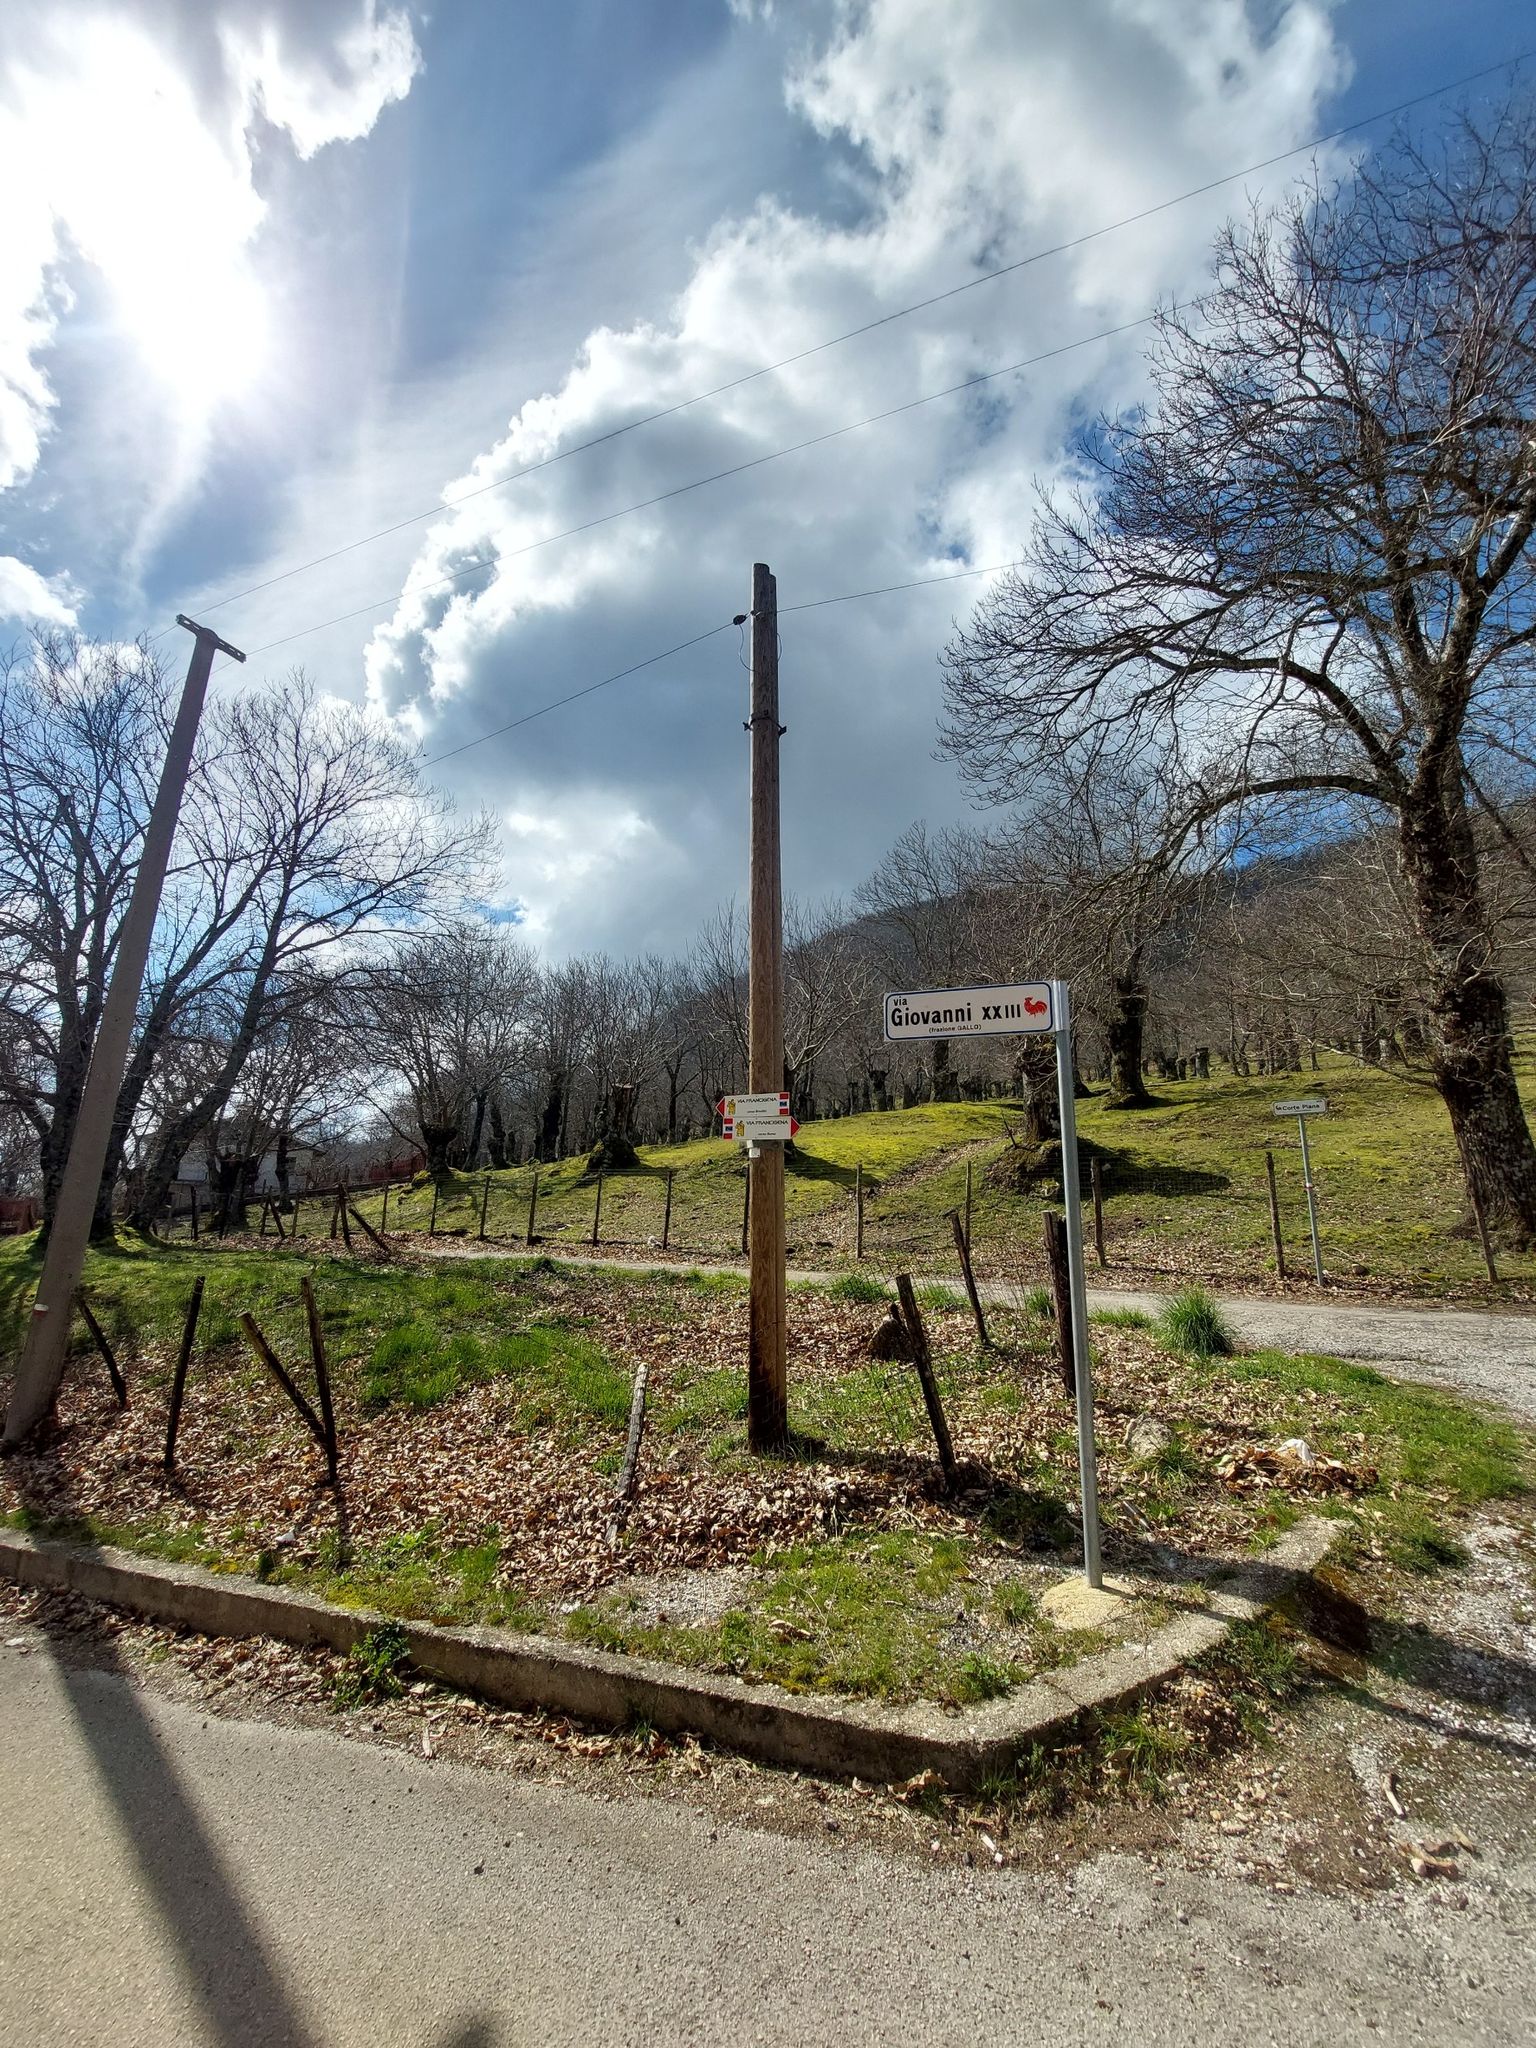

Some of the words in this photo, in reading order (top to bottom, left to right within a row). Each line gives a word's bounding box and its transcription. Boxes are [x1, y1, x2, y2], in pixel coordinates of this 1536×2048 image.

[893, 996, 908, 1006] via
[891, 1002, 972, 1026] Giovanni
[981, 1003, 1021, 1020] XXIII
